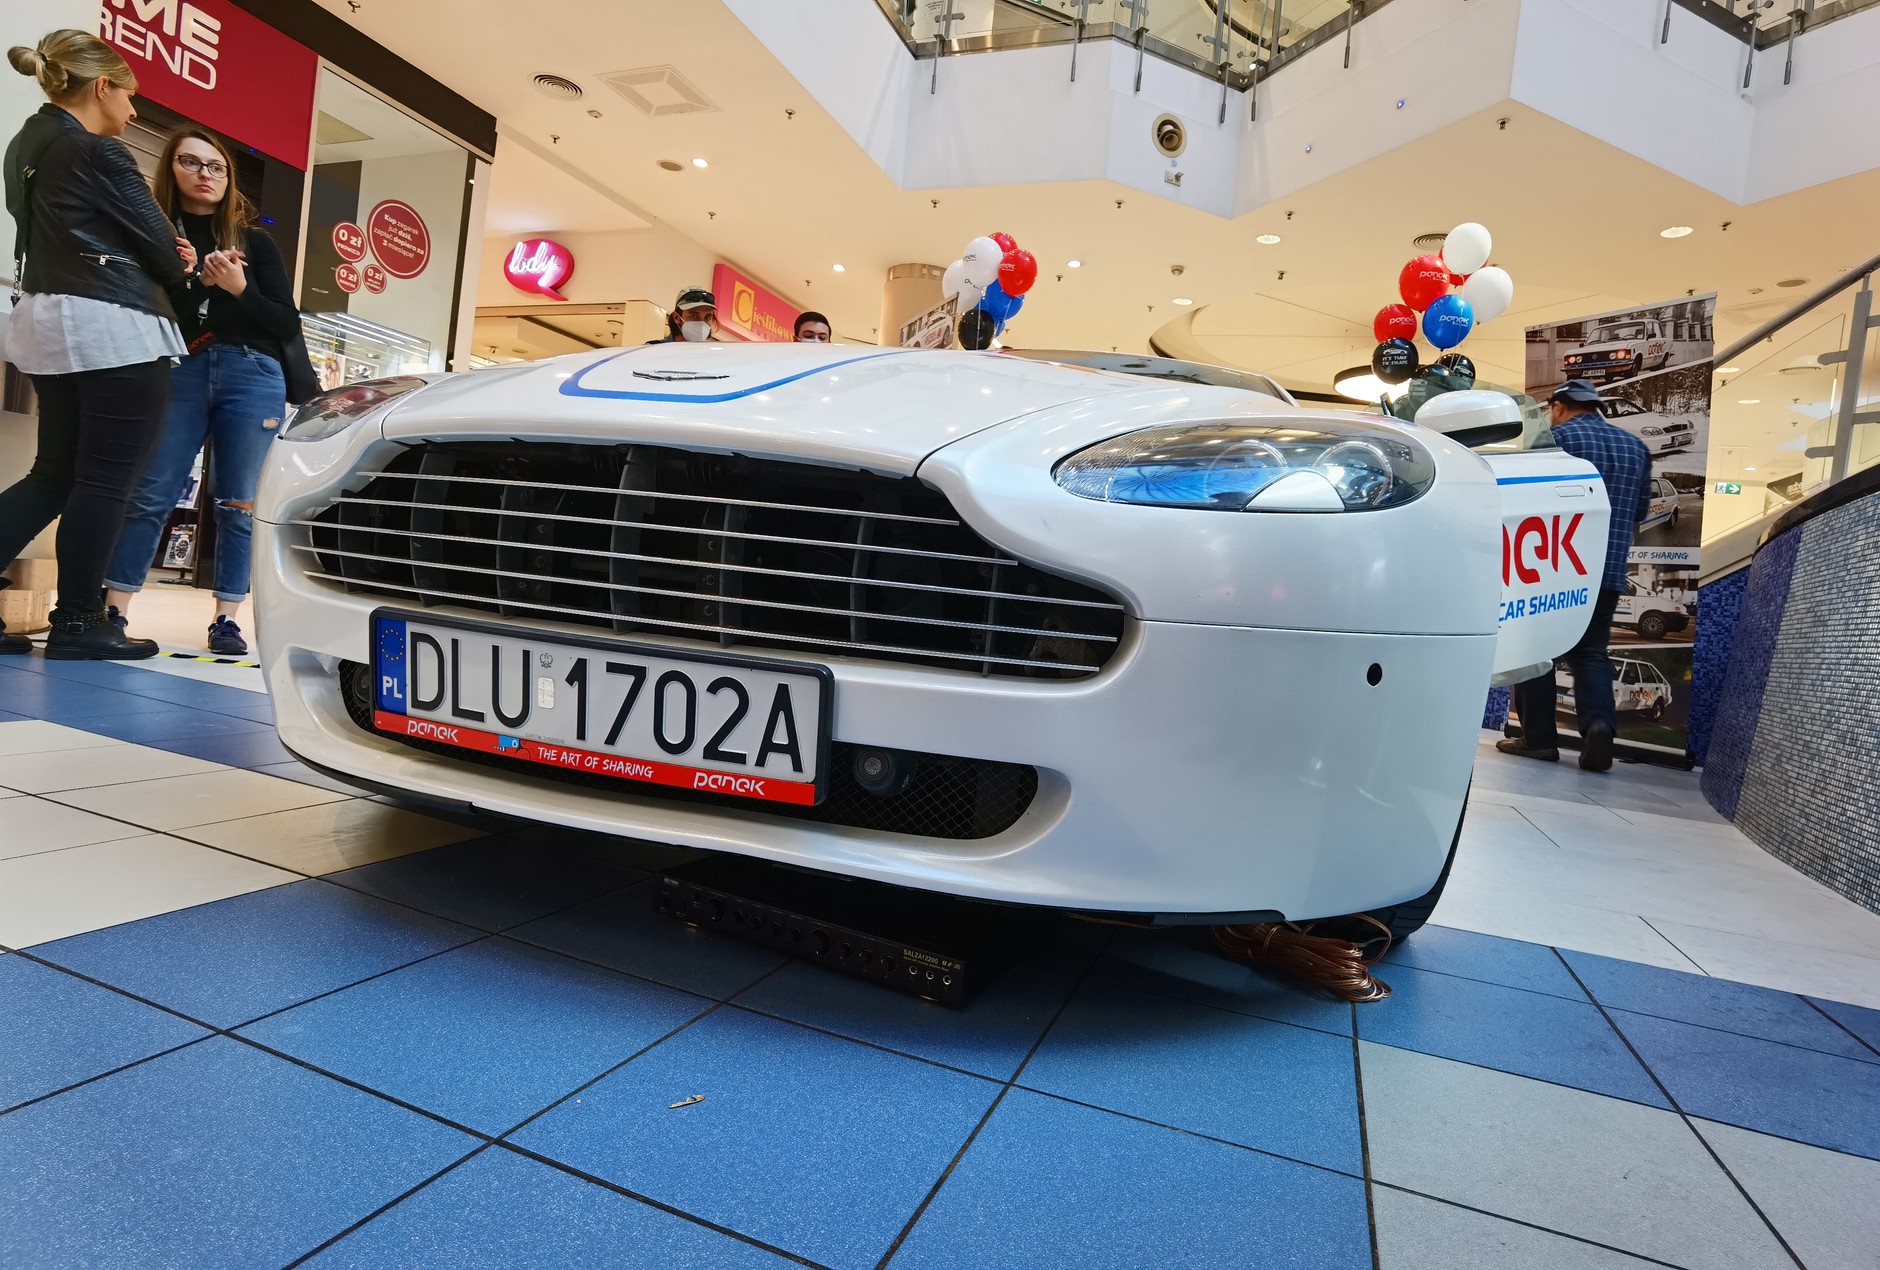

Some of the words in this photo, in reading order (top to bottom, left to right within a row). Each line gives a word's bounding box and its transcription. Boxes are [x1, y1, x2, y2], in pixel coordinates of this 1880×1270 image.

[111, 0, 222, 61] ME
[384, 213, 397, 225] Kup
[338, 229, 348, 241] 0
[349, 235, 363, 248] zł
[382, 239, 388, 247] 3
[340, 268, 347, 278] 0
[348, 273, 358, 283] zł
[367, 268, 374, 277] 0
[1638, 551, 1649, 559] OF
[1650, 551, 1689, 560] SHARING
[1529, 588, 1588, 615] SHARING
[382, 675, 403, 699] PL
[410, 631, 531, 729] DLU
[565, 656, 804, 774] 1702A
[407, 719, 459, 743] panek
[538, 746, 558, 761] THE
[560, 751, 582, 766] ART
[584, 755, 600, 769] OF
[602, 759, 654, 779] SHARING
[693, 771, 766, 797] panek
